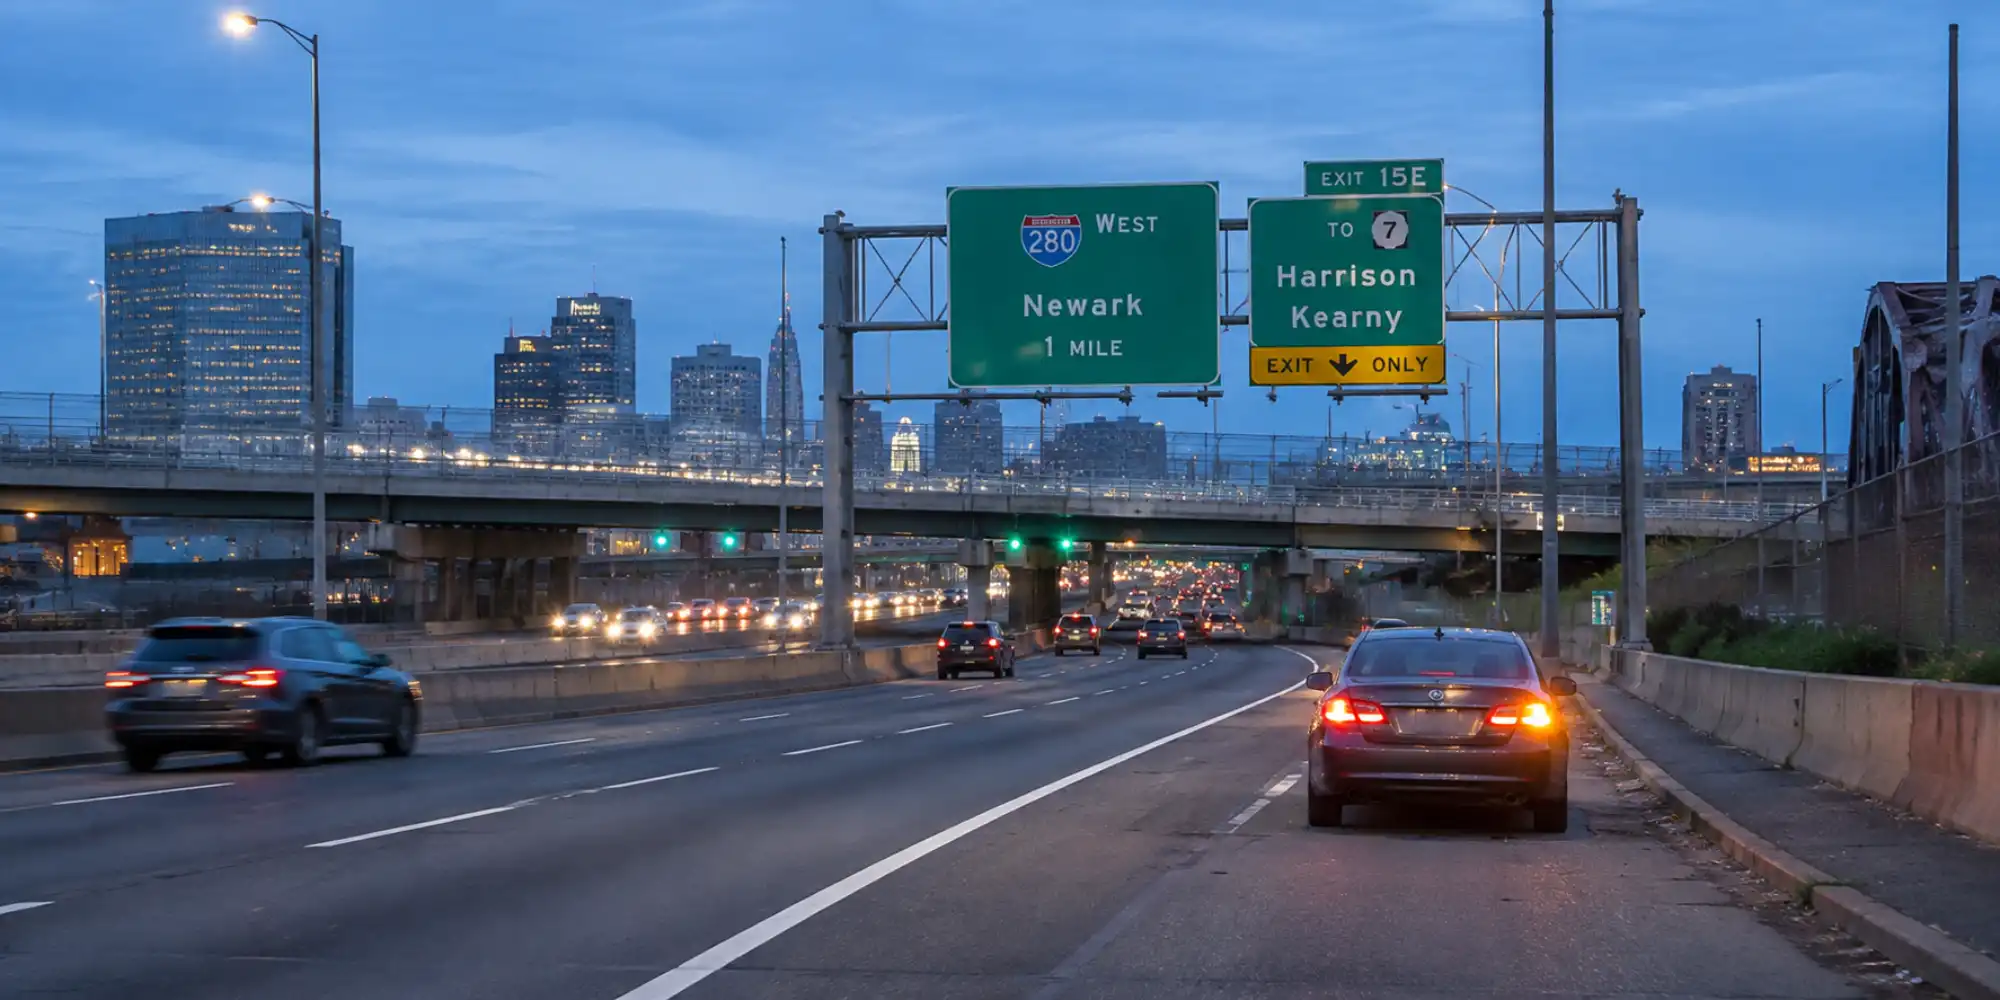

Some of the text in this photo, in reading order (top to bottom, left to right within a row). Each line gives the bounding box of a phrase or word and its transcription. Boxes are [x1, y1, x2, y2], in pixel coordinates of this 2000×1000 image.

[1321, 166, 1427, 187] EXIT 15E
[1095, 213, 1159, 233] WEST
[1327, 221, 1397, 239] TO 7
[1028, 229, 1076, 254] 280
[1277, 264, 1416, 288] Harrison
[1023, 293, 1143, 317] Newark
[1291, 305, 1403, 335] Kearny
[1044, 335, 1123, 357] 1 MILE
[1267, 356, 1429, 374] EXIT ONLY
